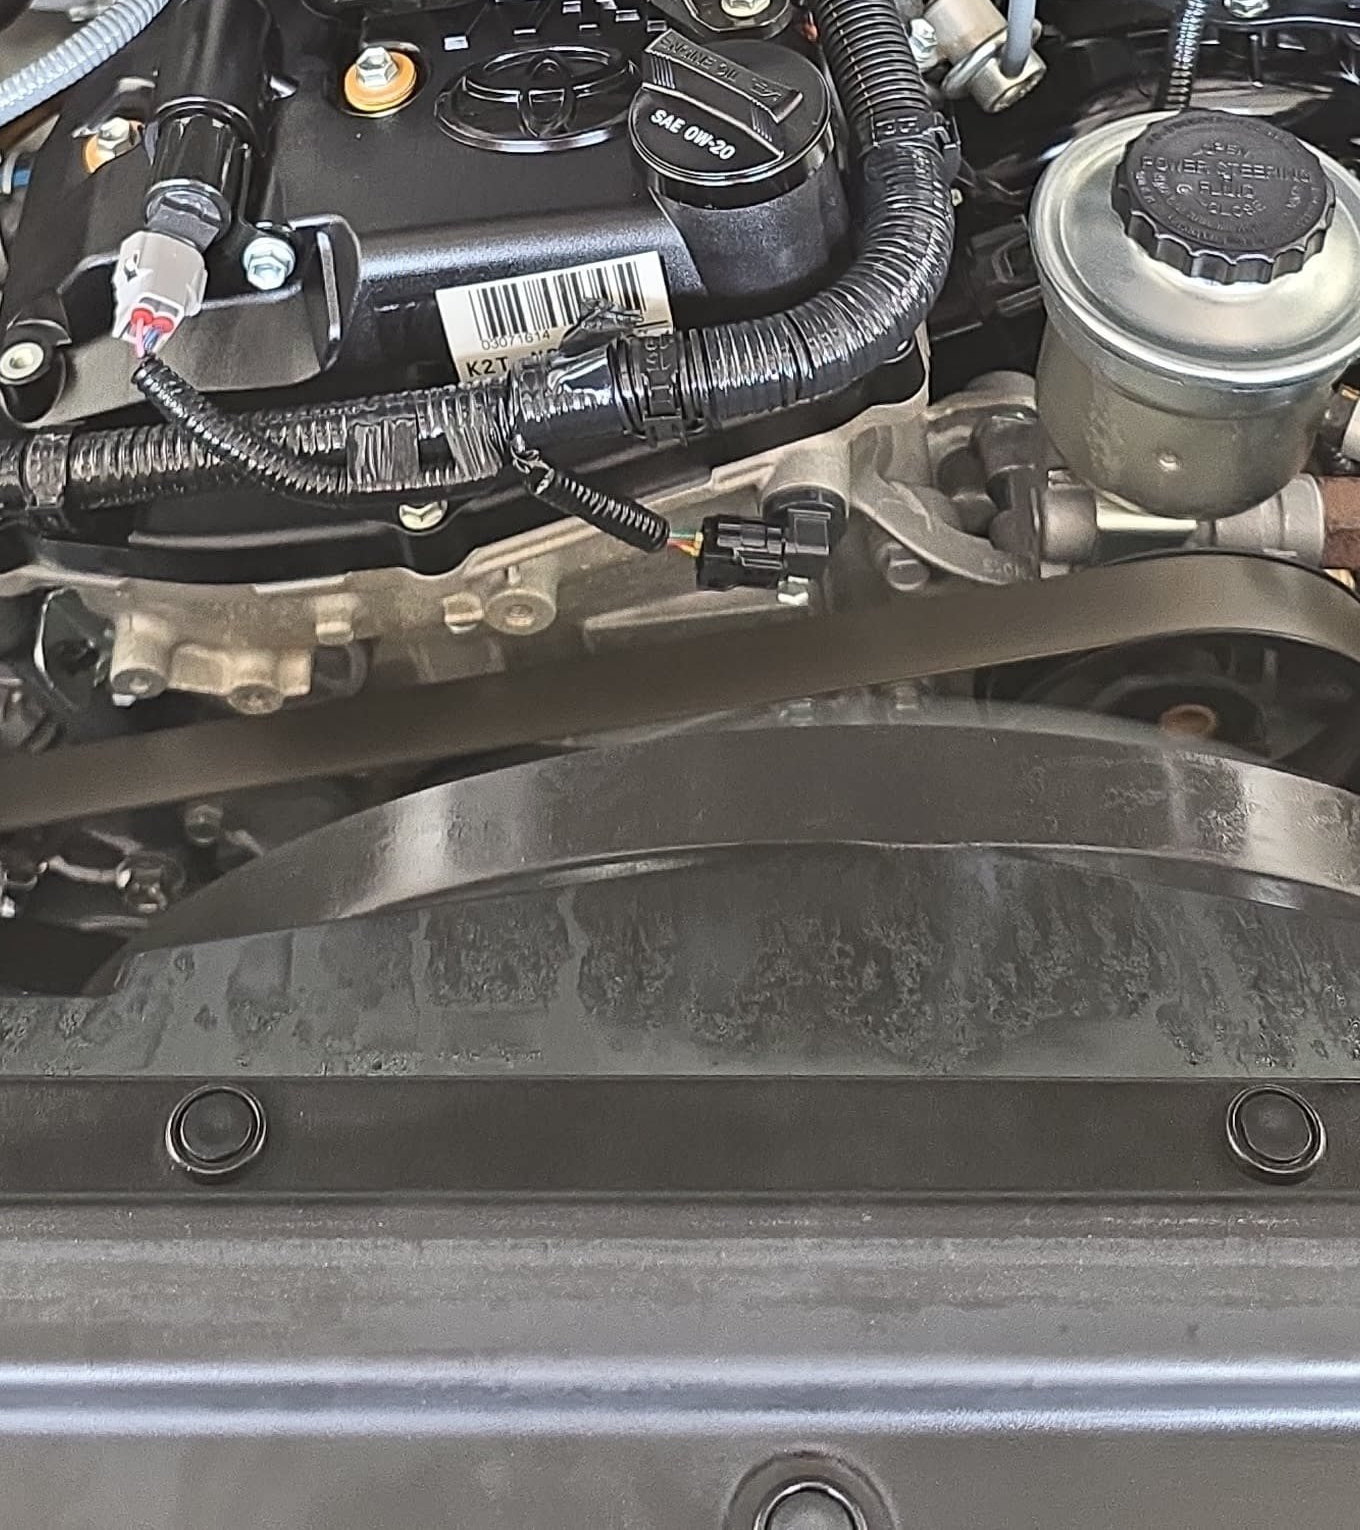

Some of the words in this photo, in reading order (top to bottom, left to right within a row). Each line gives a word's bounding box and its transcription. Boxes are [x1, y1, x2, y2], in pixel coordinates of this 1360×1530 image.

[650, 110, 685, 134] SAE
[684, 126, 735, 160] 0W-20
[1142, 156, 1208, 176] POWER
[1217, 160, 1312, 184] STEERING
[481, 329, 551, 351] 03071614
[466, 355, 510, 378] K2T
